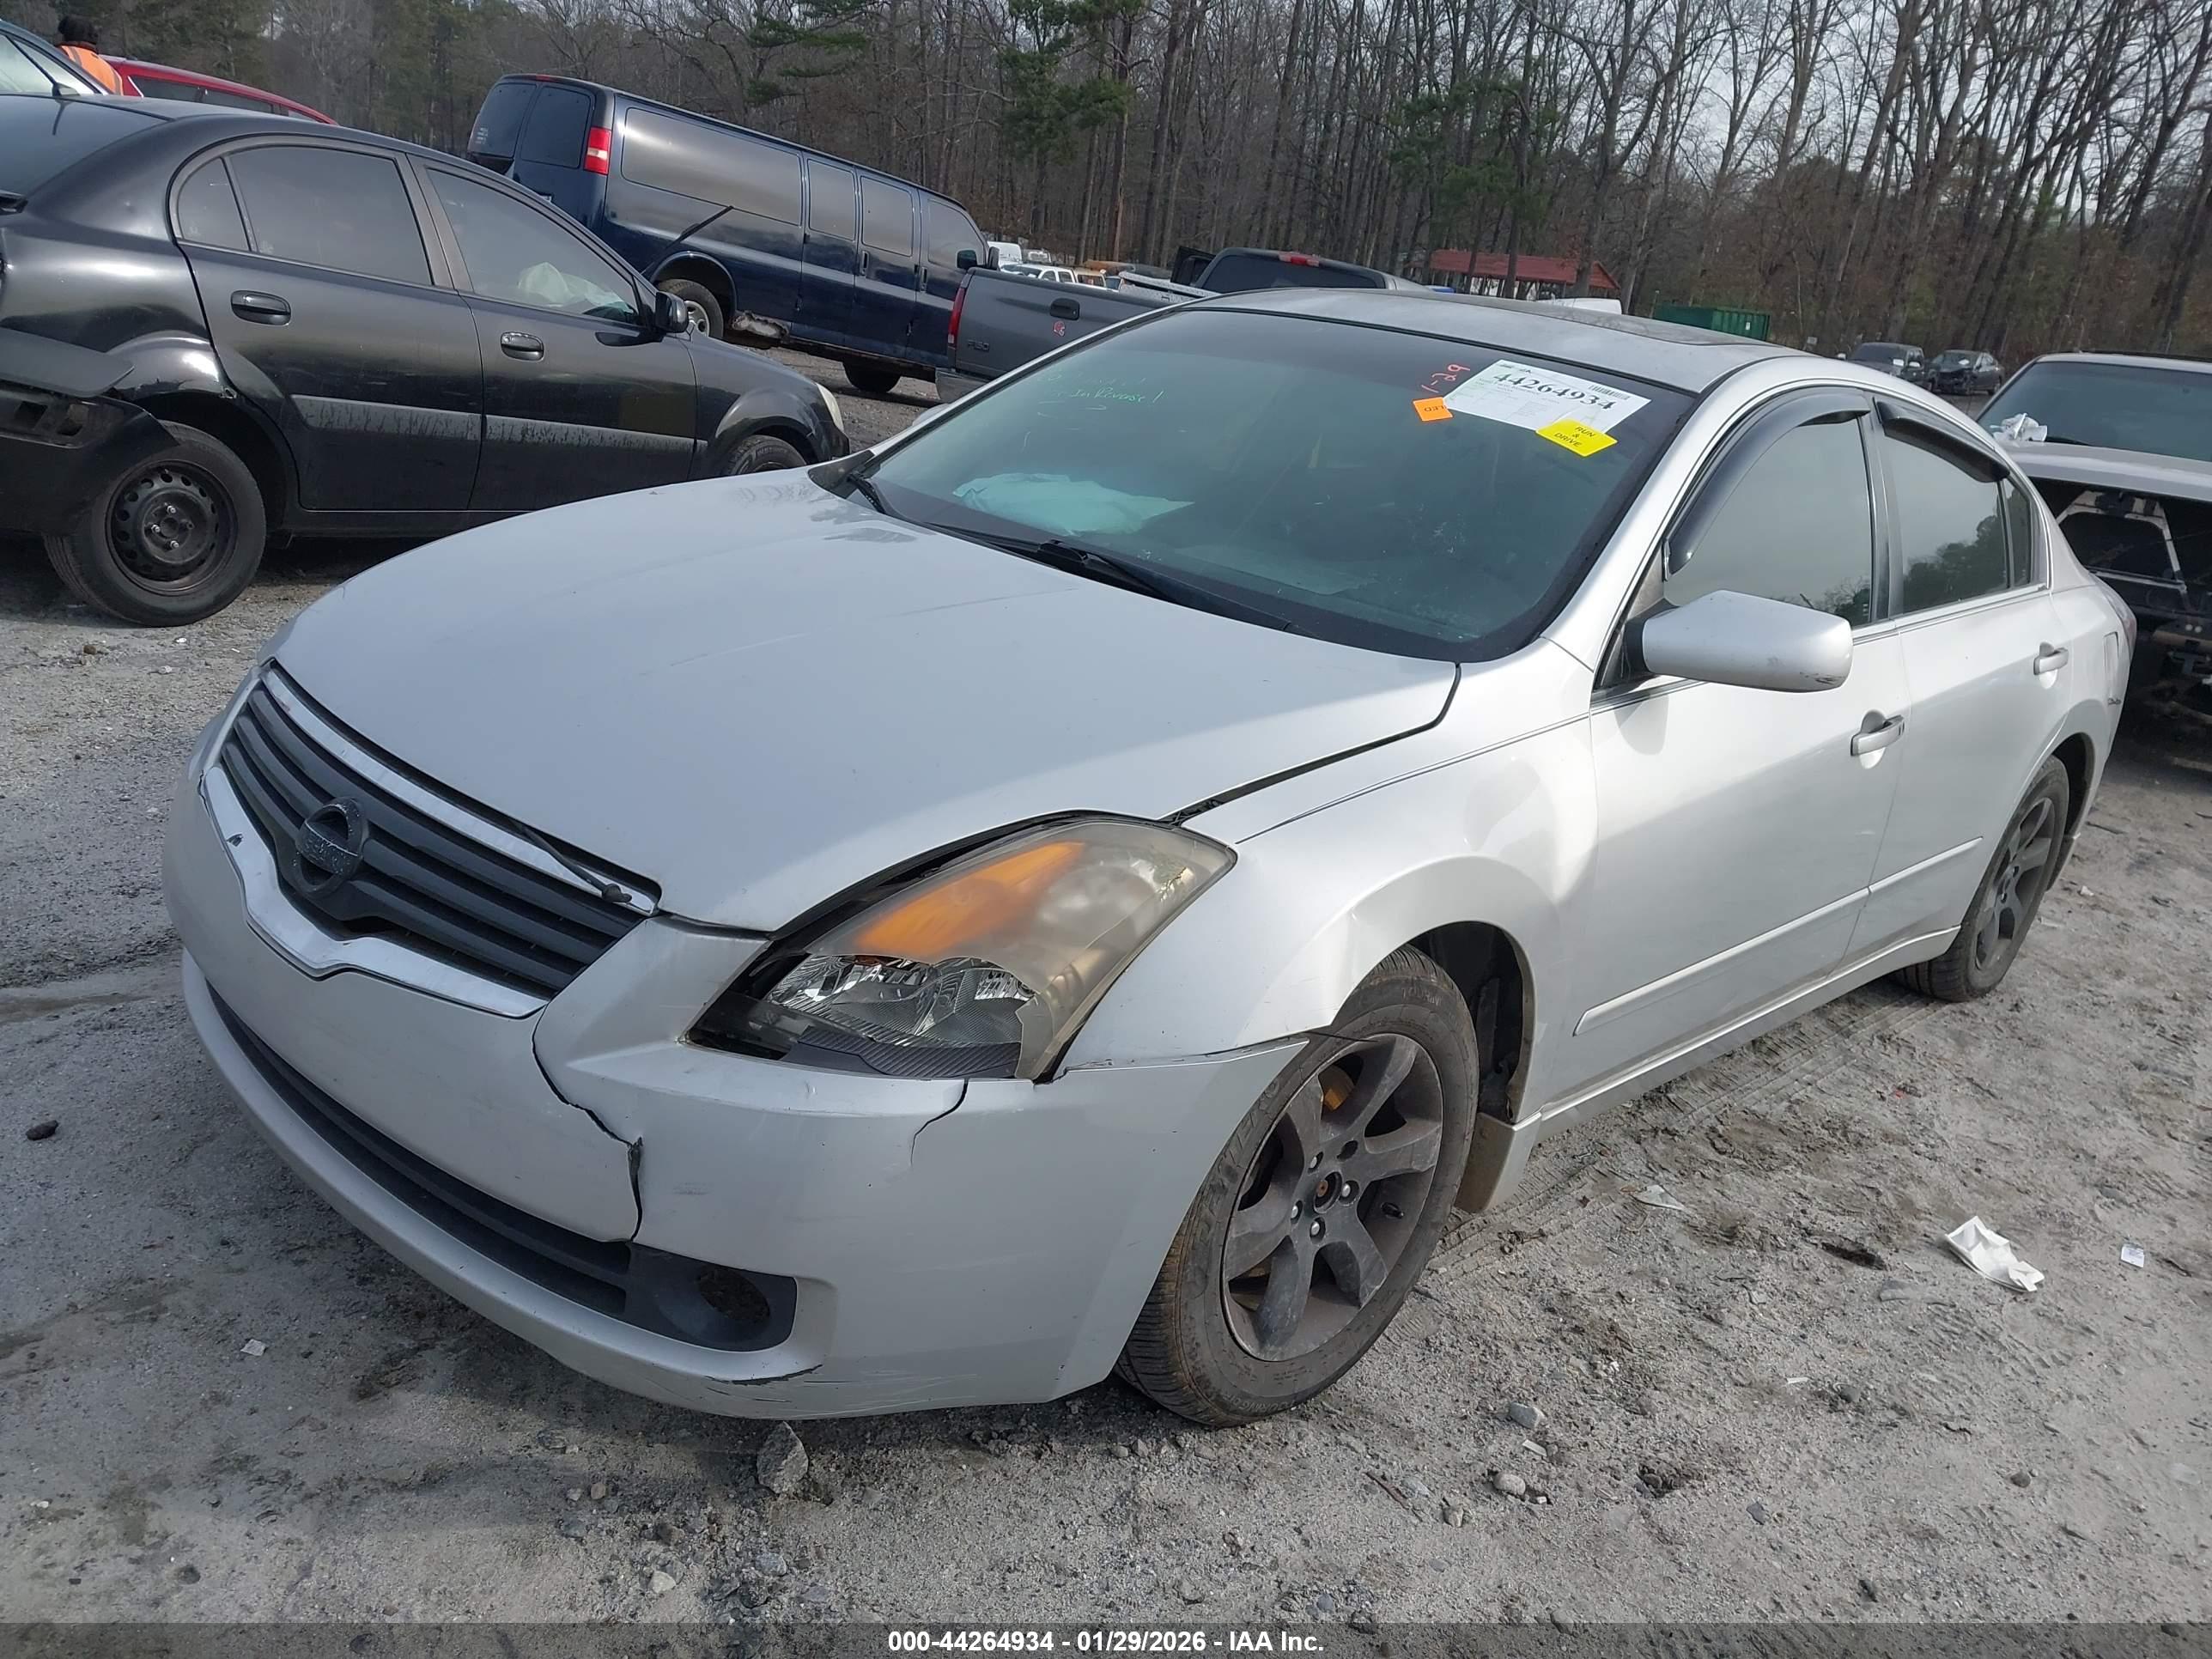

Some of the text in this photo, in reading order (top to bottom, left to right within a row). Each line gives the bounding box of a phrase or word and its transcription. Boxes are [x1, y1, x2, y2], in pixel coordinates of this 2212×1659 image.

[1421, 363, 1470, 393] 1-29
[1493, 373, 1616, 410] 44264934
[1553, 432, 1582, 447] DRIVE
[1574, 425, 1595, 437] RUN
